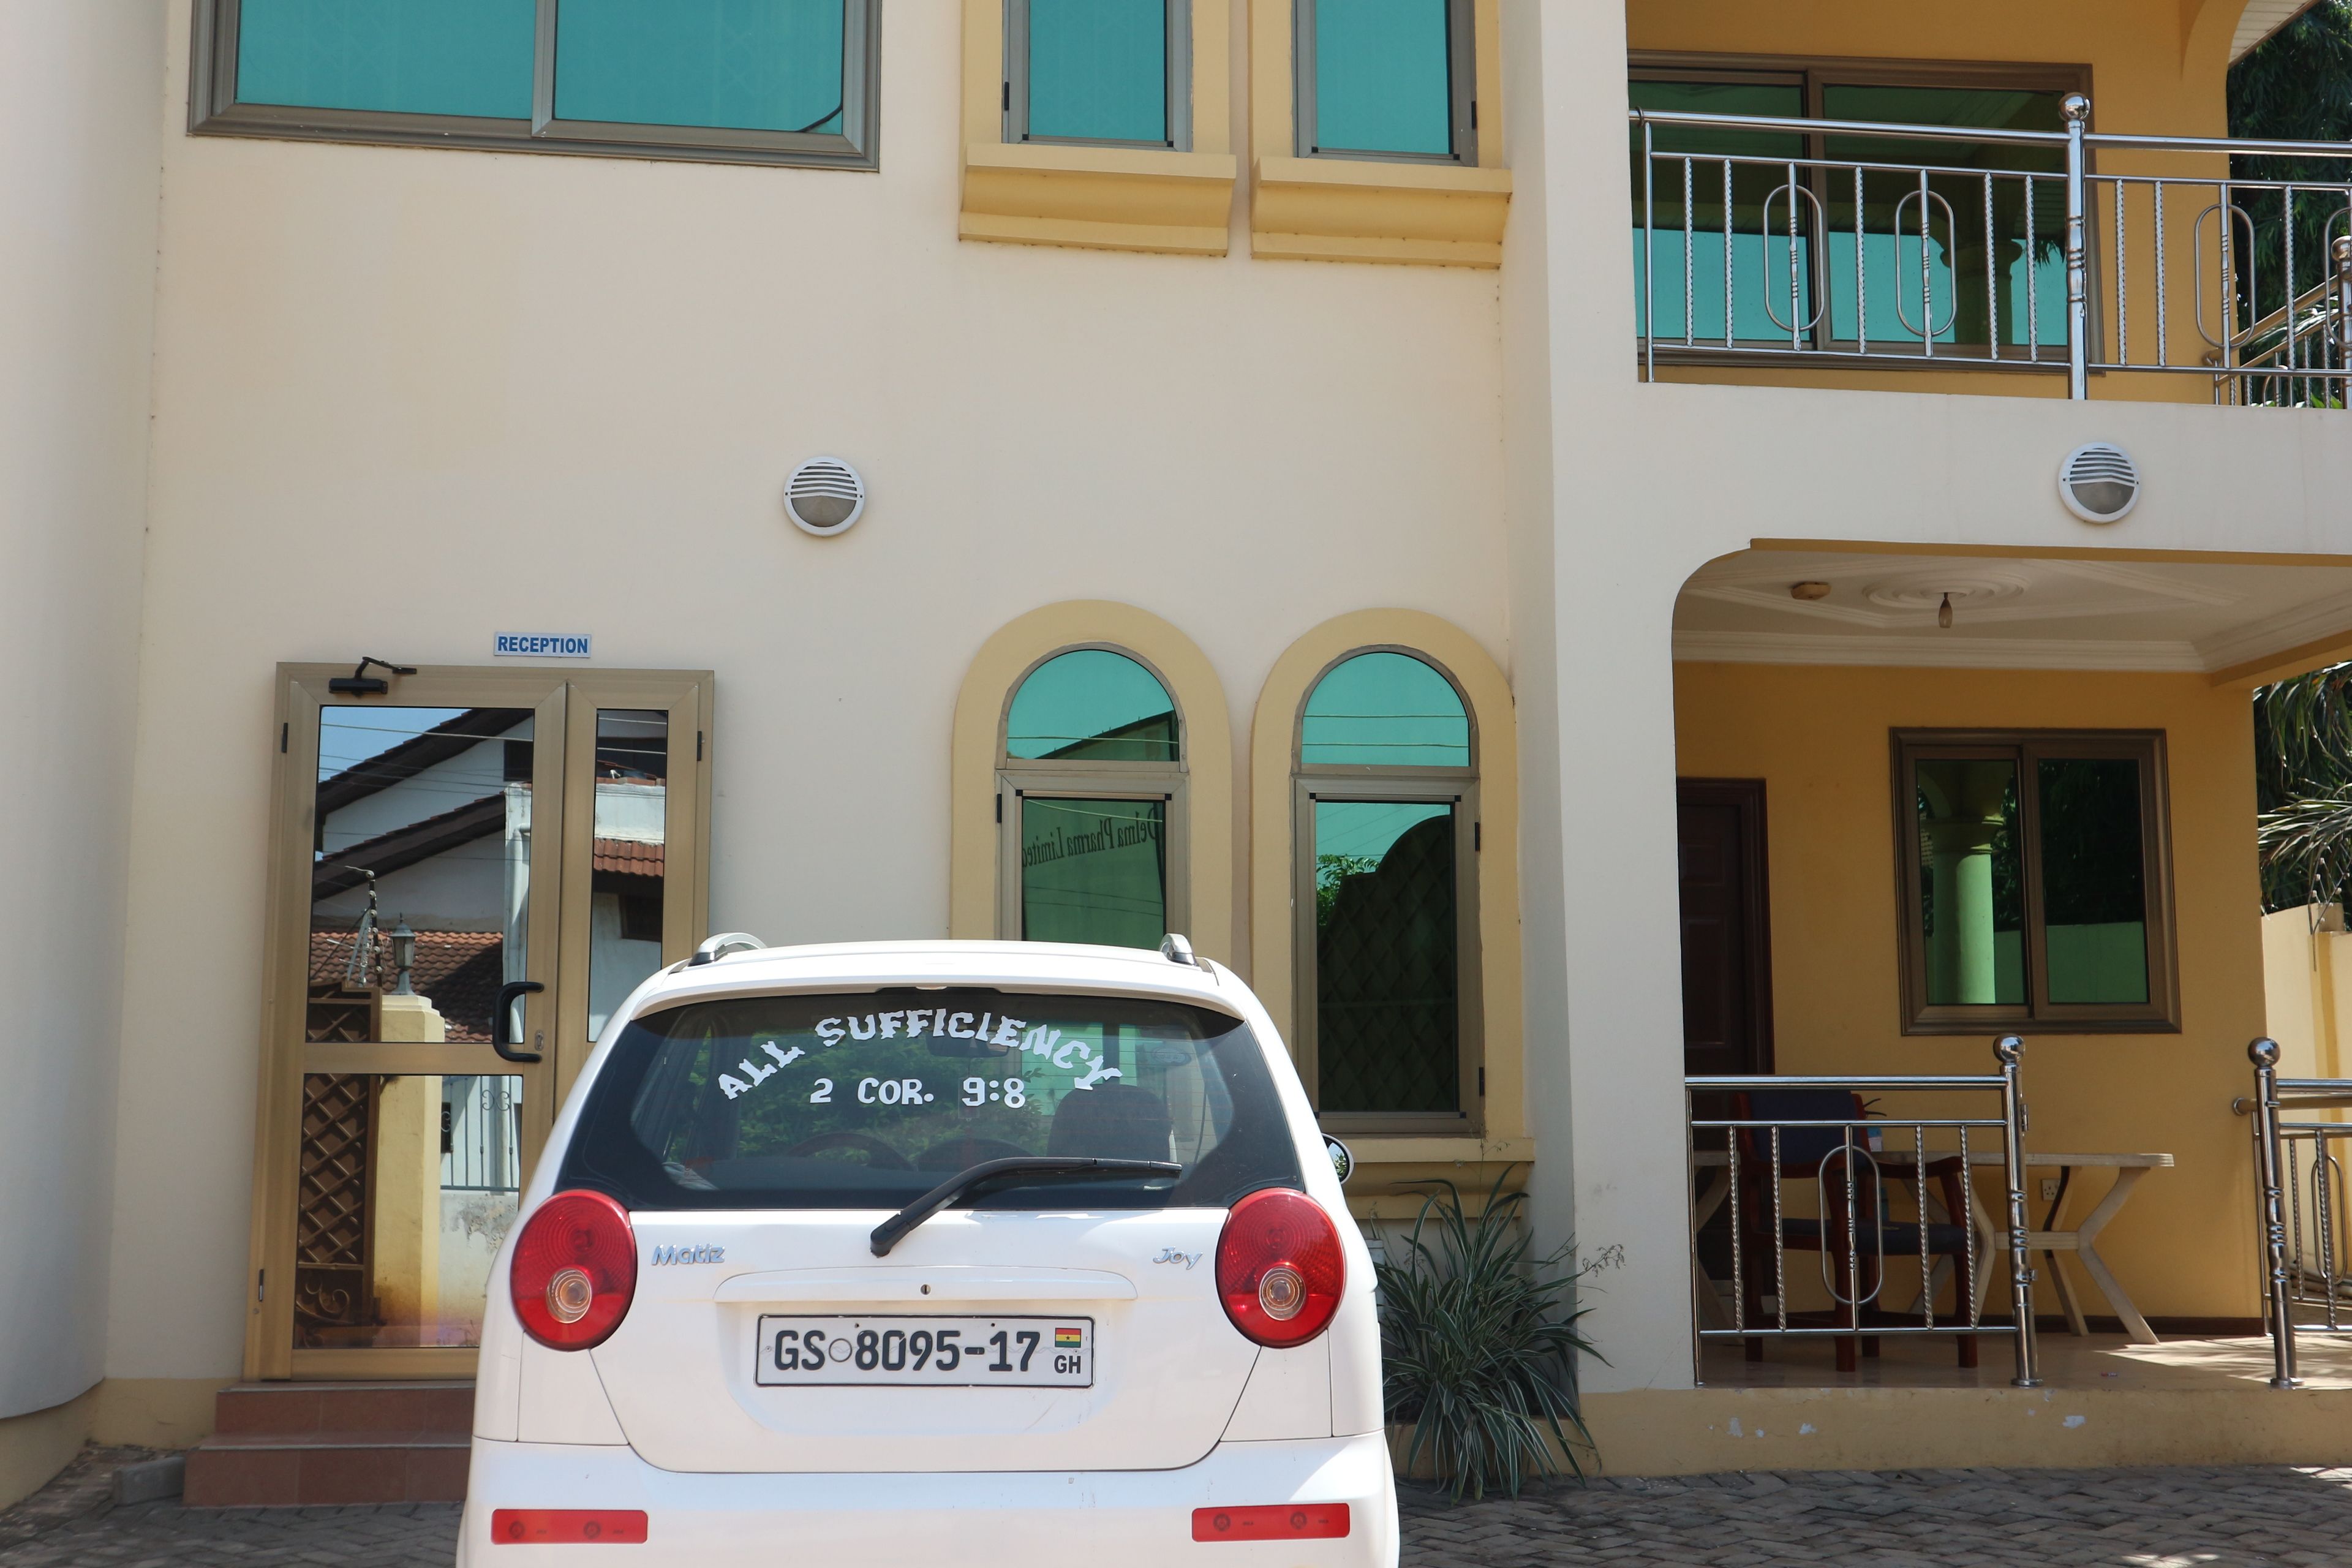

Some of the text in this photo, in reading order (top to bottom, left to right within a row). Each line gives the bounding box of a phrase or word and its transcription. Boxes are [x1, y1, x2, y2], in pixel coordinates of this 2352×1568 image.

[497, 636, 588, 654] RECEPTION
[717, 1008, 1123, 1100] ALL SUFFICIENCY
[810, 1077, 1026, 1109] 2 COR. 9:8
[651, 1243, 725, 1266] Matiz
[1153, 1246, 1203, 1270] Joy
[1054, 1355, 1082, 1374] GH
